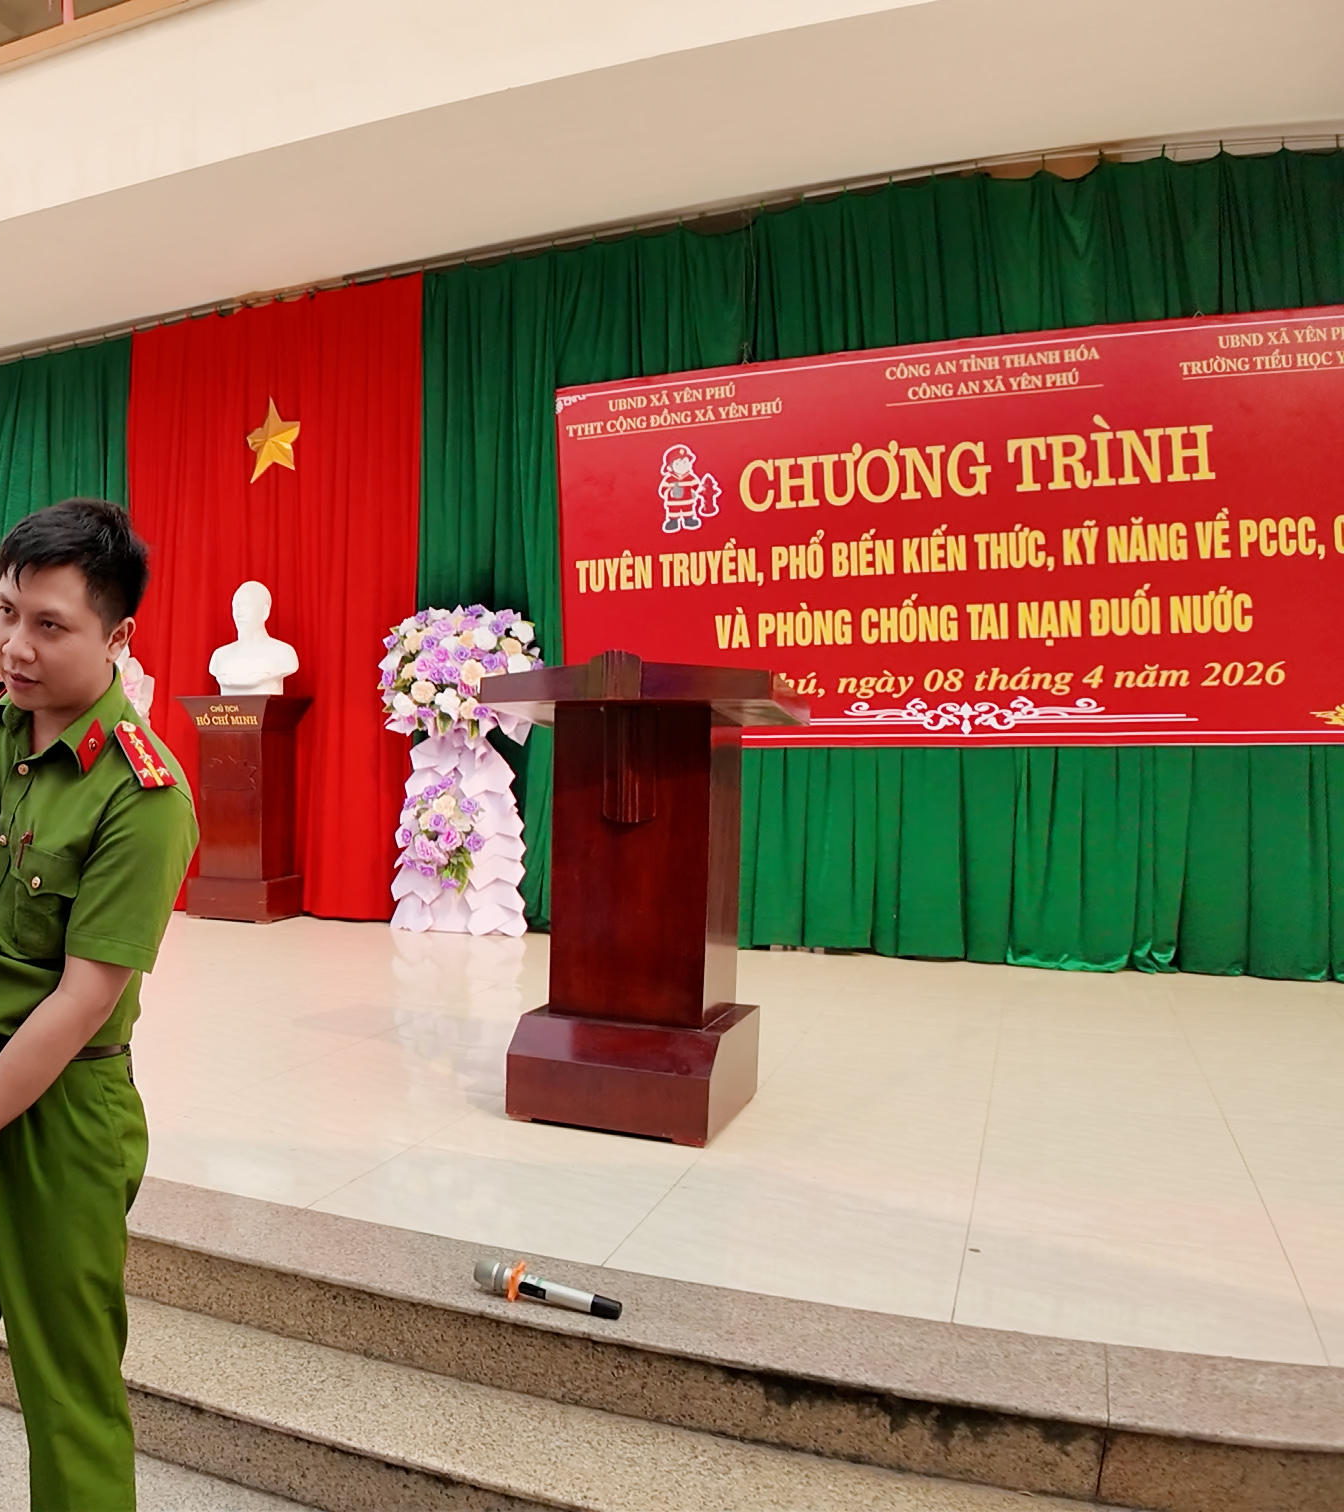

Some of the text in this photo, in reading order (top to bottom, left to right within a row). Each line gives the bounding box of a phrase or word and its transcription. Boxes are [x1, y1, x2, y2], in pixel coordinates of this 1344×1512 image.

[1218, 332, 1264, 348] UBND
[1268, 328, 1290, 345] XÃ
[1293, 325, 1327, 342] YÊN
[885, 344, 1100, 380] CÔNG AN TỈNH THANH HÓA
[1179, 356, 1250, 375] TRƯỜNG
[1253, 348, 1292, 370] TIỂU
[1296, 352, 1332, 369] HỌC
[608, 382, 736, 412] UBND XÃ YÊN PHÚ
[908, 368, 1080, 400] CÔNG AN XÃ YÊN PHÚ
[566, 397, 783, 437] TTHT CỘNG ĐỒNG XÃ YÊN PHÚ
[739, 414, 1216, 512] CHƯƠNG TRÌNH
[576, 550, 652, 594] TUYÊN
[659, 538, 764, 586] TRUYỀN,
[772, 529, 825, 580] PHỔ
[832, 528, 895, 578] BIẾN
[902, 524, 967, 574] KIẾN
[974, 523, 1055, 572] THỨC,
[1062, 520, 1099, 566] KỸ
[1107, 516, 1188, 564] NĂNG
[1194, 507, 1232, 560] VỀ
[1239, 516, 1326, 560] PCCC,
[714, 583, 1253, 649] VÀ PHÒNG CHỐNG TAI NẠN ĐUỐI NƯỚC
[837, 670, 914, 700] ngày
[923, 668, 964, 693] 08
[974, 666, 1074, 696] tháng
[1082, 664, 1104, 690] 4
[1113, 663, 1190, 689] năm
[1200, 660, 1286, 687] 2026
[212, 714, 230, 725] CHÍ
[230, 716, 258, 725] MINH
